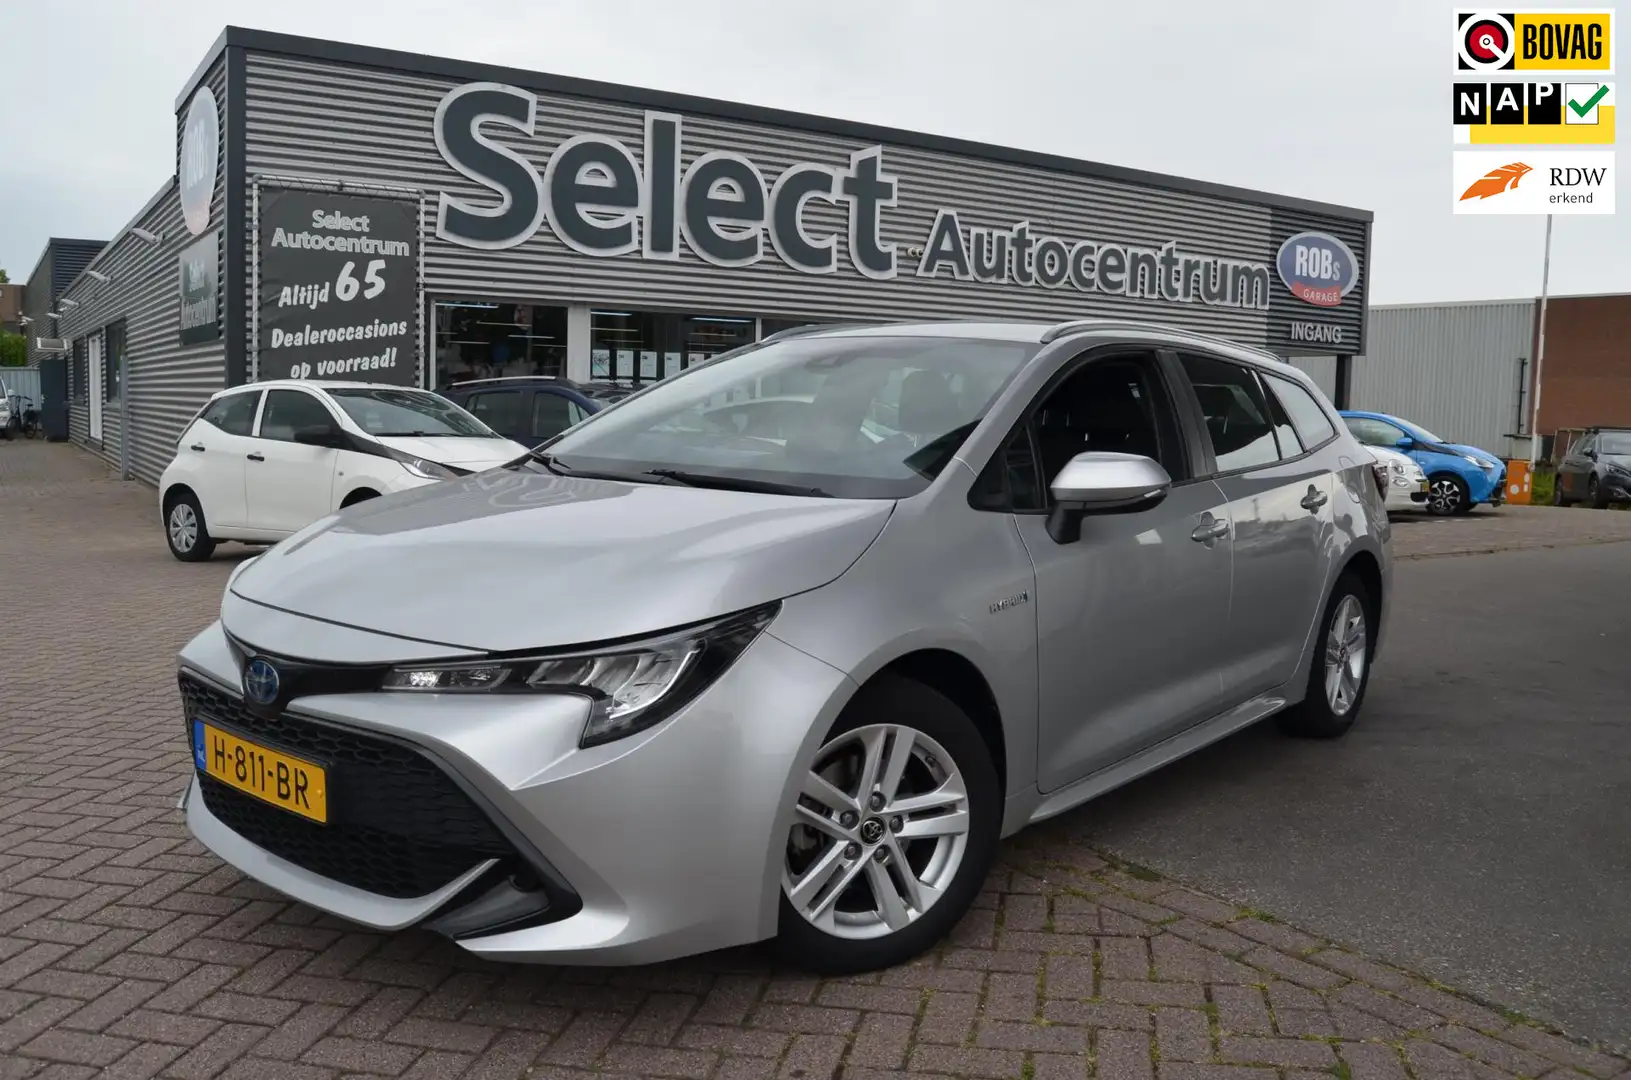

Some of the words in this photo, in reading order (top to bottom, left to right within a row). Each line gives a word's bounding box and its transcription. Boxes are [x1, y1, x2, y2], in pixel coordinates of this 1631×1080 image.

[433, 81, 897, 279] Select
[915, 208, 1270, 310] Autocentrum
[312, 209, 370, 232] Select
[271, 227, 410, 256] Autocentrum
[278, 281, 330, 310] Altijd
[335, 259, 386, 301] 65
[1303, 288, 1339, 302] GARAGE
[271, 318, 408, 349] Dealeroccasions
[1291, 321, 1342, 344] INGANG
[290, 362, 311, 380] op
[317, 347, 398, 376] voorraad!
[213, 735, 310, 810] H-811-BR
